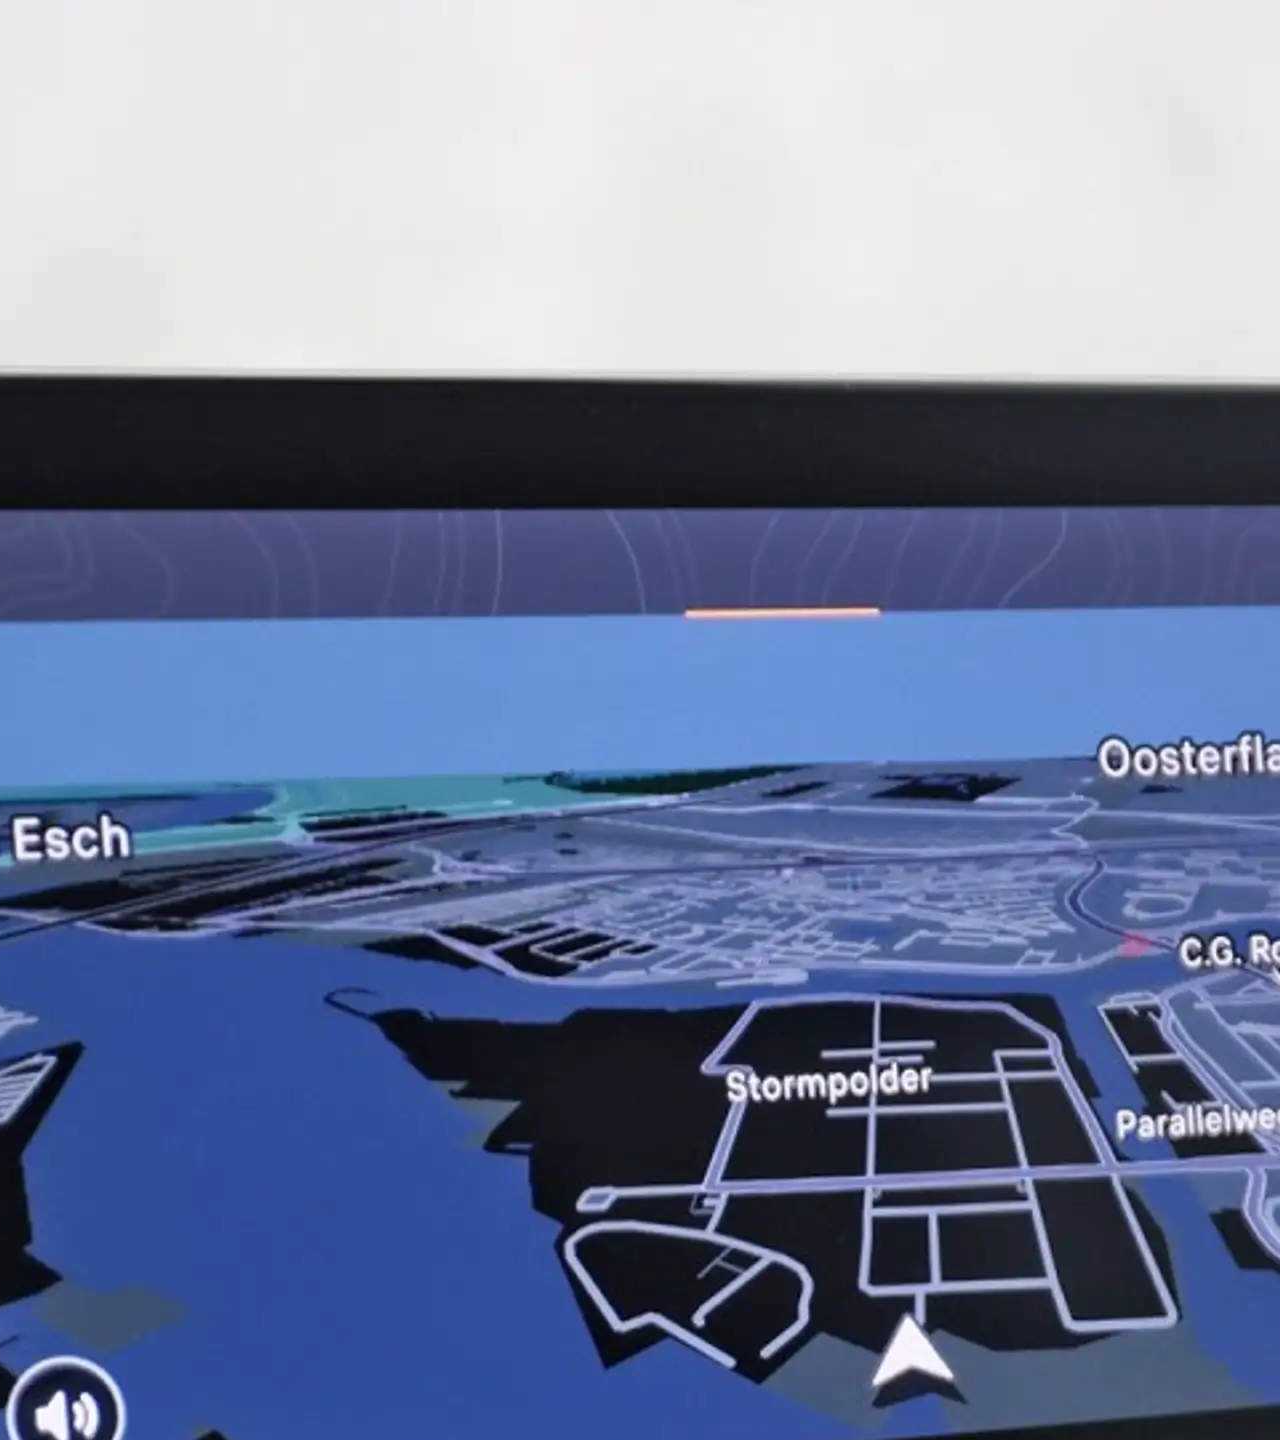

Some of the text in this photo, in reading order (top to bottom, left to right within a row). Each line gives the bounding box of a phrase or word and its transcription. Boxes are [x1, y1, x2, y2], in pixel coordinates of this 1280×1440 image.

[13, 811, 132, 861] Esch
[1179, 936, 1244, 970] C.G.
[725, 1065, 934, 1105] Stormpolder
